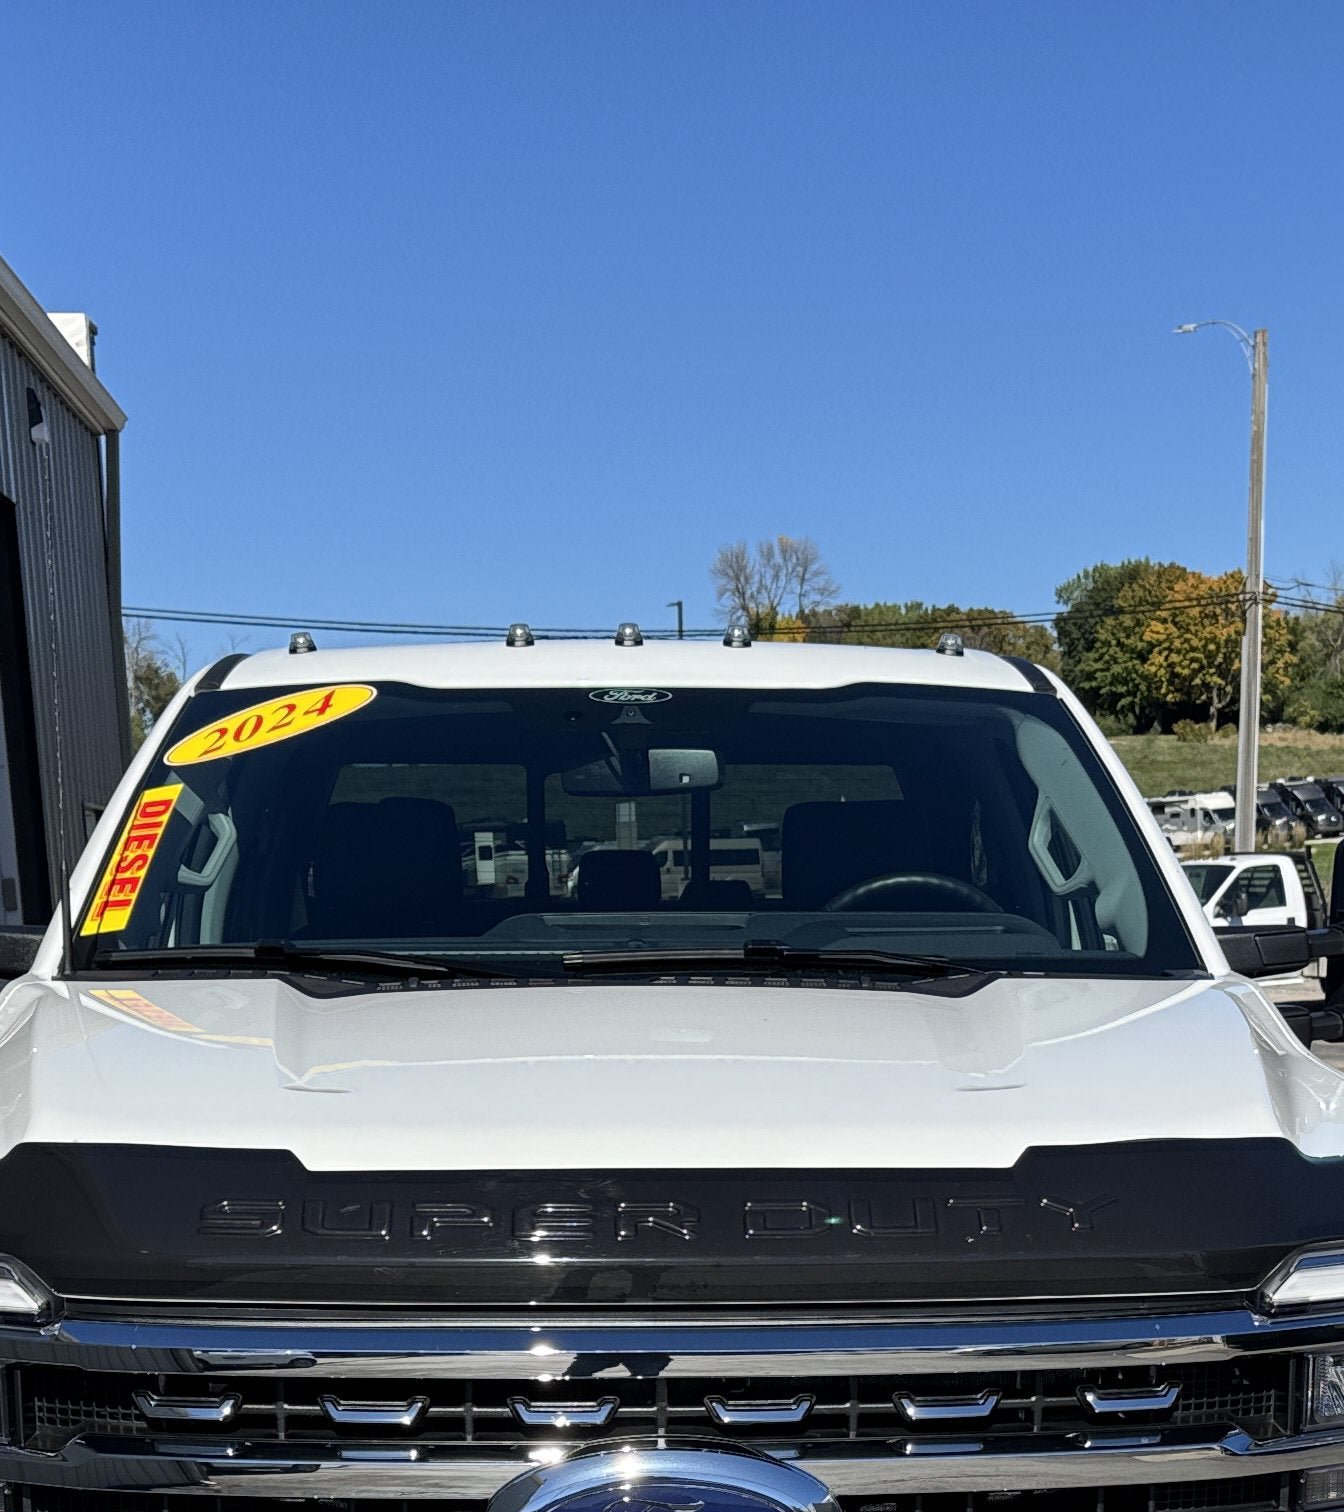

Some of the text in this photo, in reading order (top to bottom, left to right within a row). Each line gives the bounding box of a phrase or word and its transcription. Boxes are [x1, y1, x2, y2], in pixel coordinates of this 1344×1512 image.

[603, 690, 658, 701] Ford
[198, 689, 337, 759] 2024
[94, 798, 174, 919] DIESEL
[197, 1198, 1119, 1241] SUPER DUTY
